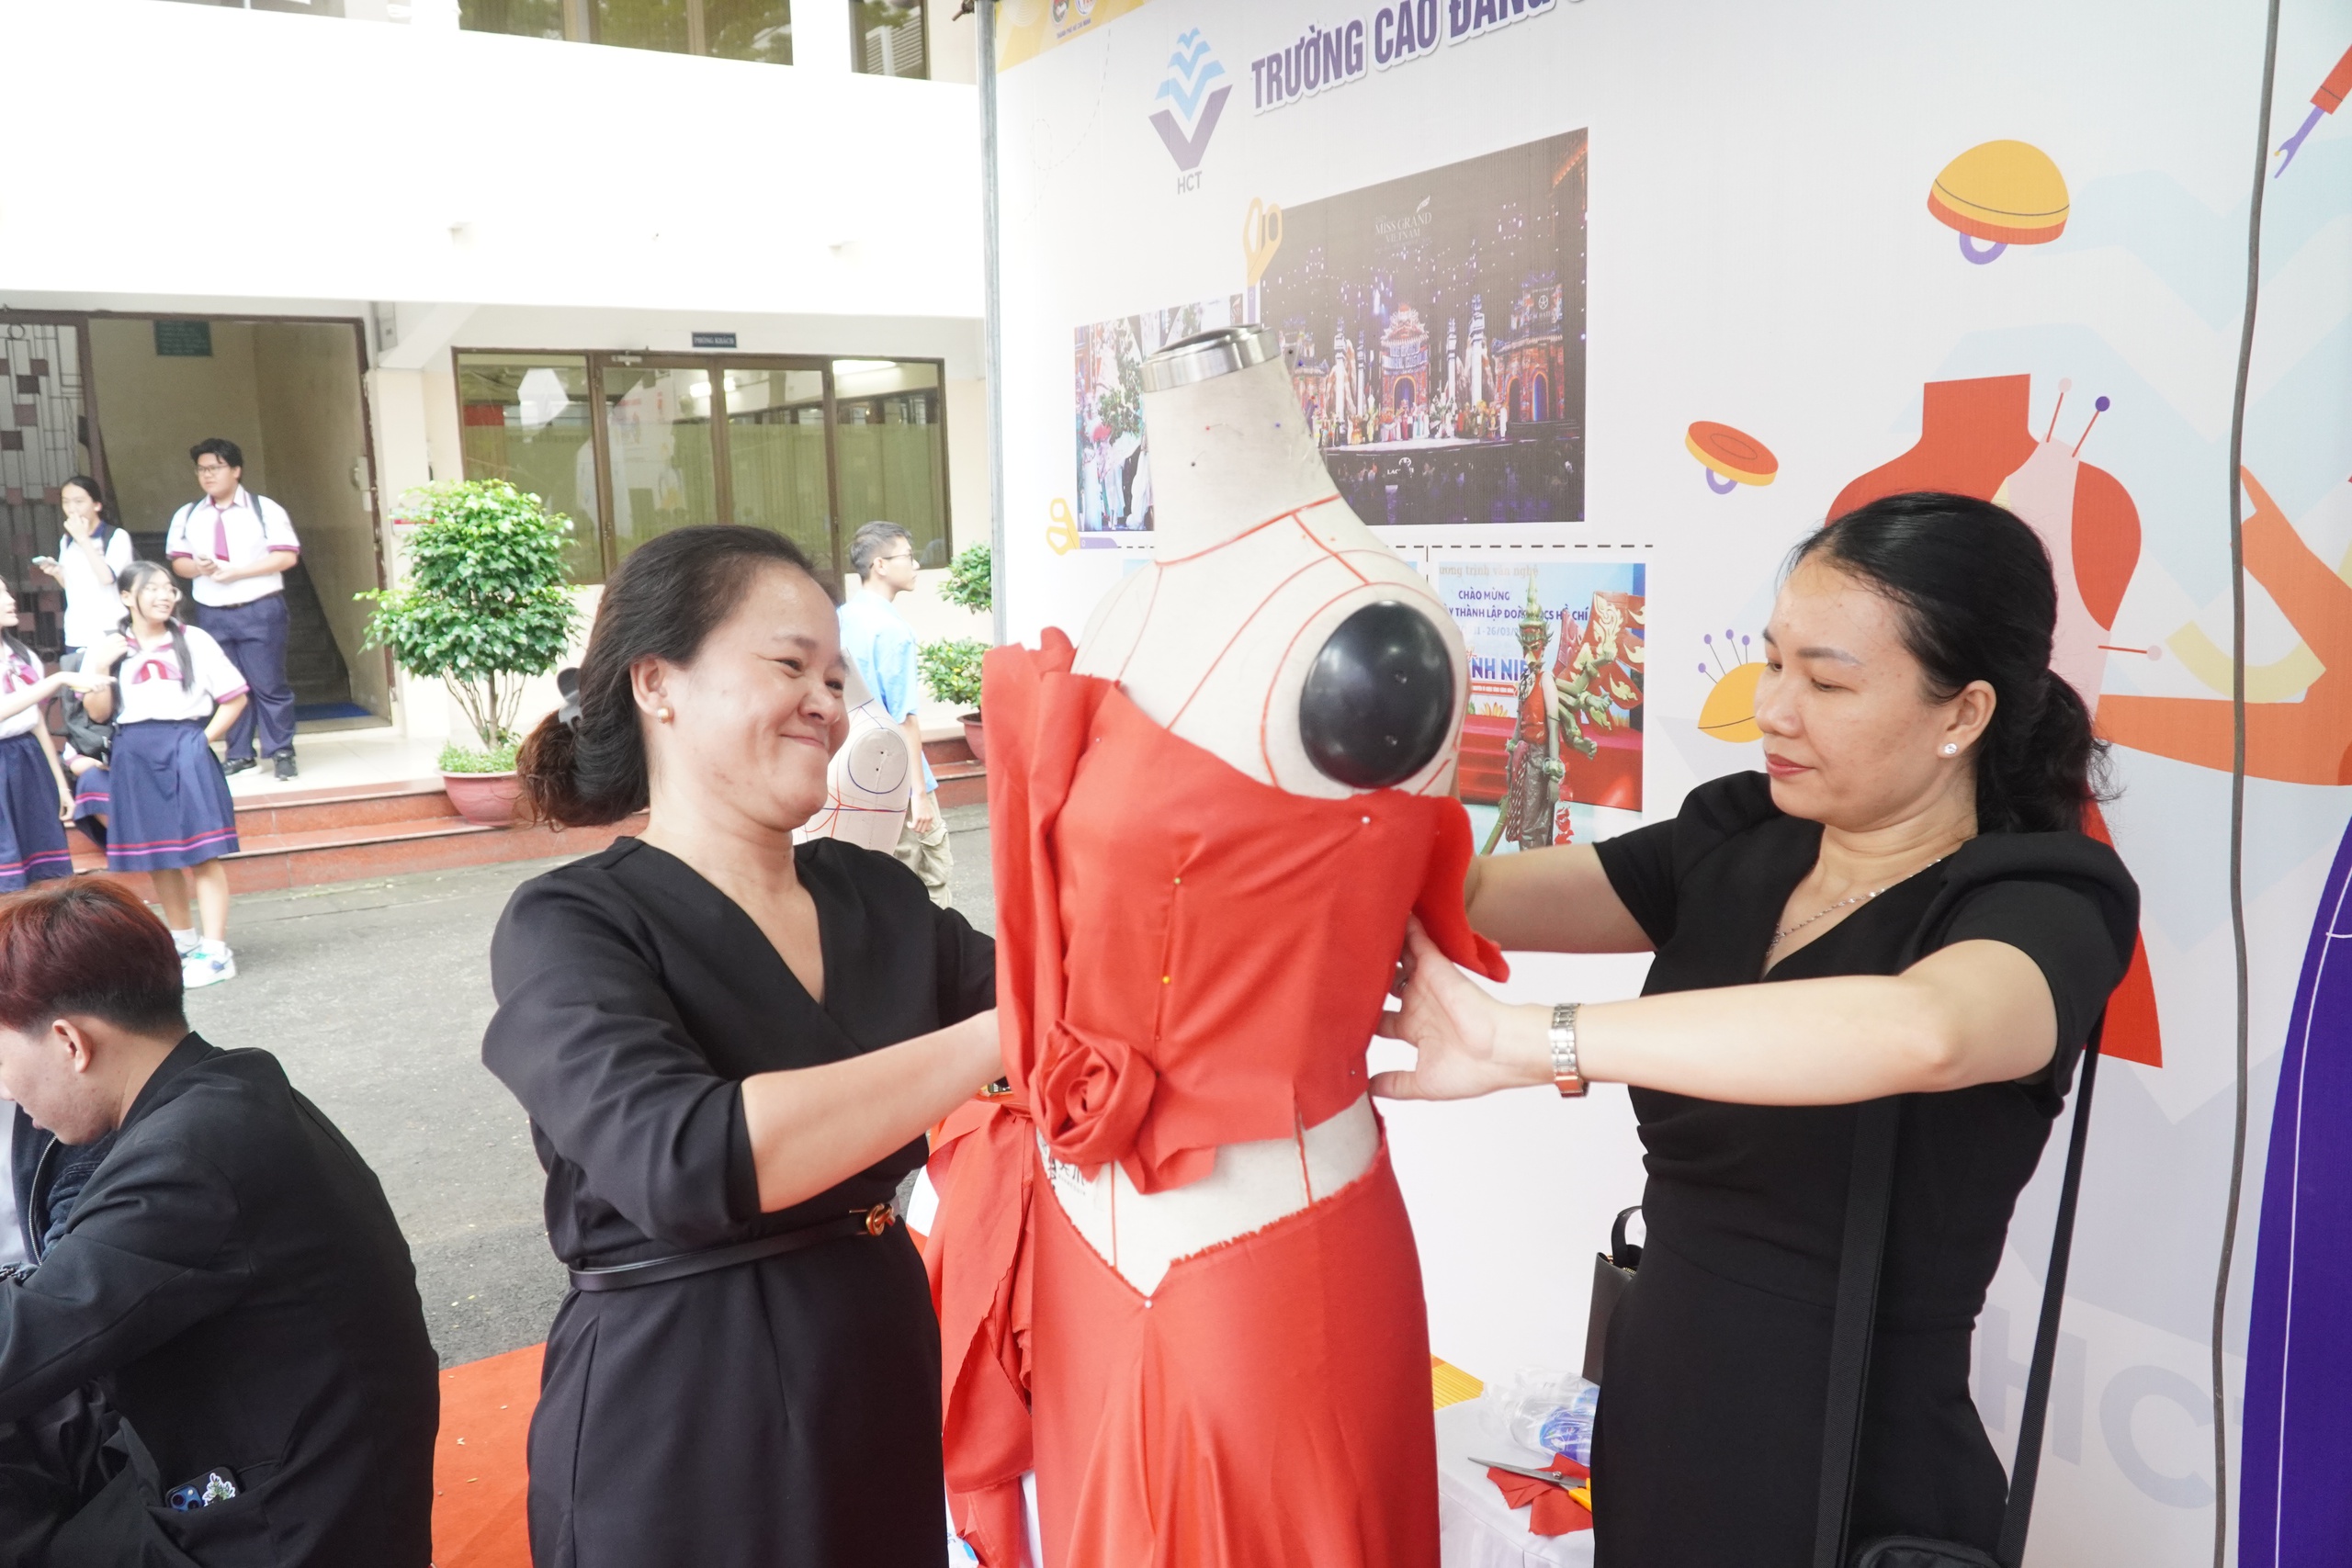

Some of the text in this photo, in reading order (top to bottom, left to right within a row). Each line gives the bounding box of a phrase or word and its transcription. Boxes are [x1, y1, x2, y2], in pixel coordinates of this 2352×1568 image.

[1250, 19, 1364, 109] TRƯỜNG
[1374, 0, 1438, 65] CAO
[1177, 170, 1203, 196] HCT
[1374, 212, 1432, 235] MISS GRAND
[1458, 587, 1510, 601] CHÀO MỪNG
[1455, 604, 1486, 617] THÀNH
[1487, 604, 1502, 622] LẬP
[1571, 605, 1589, 621] CHÍ
